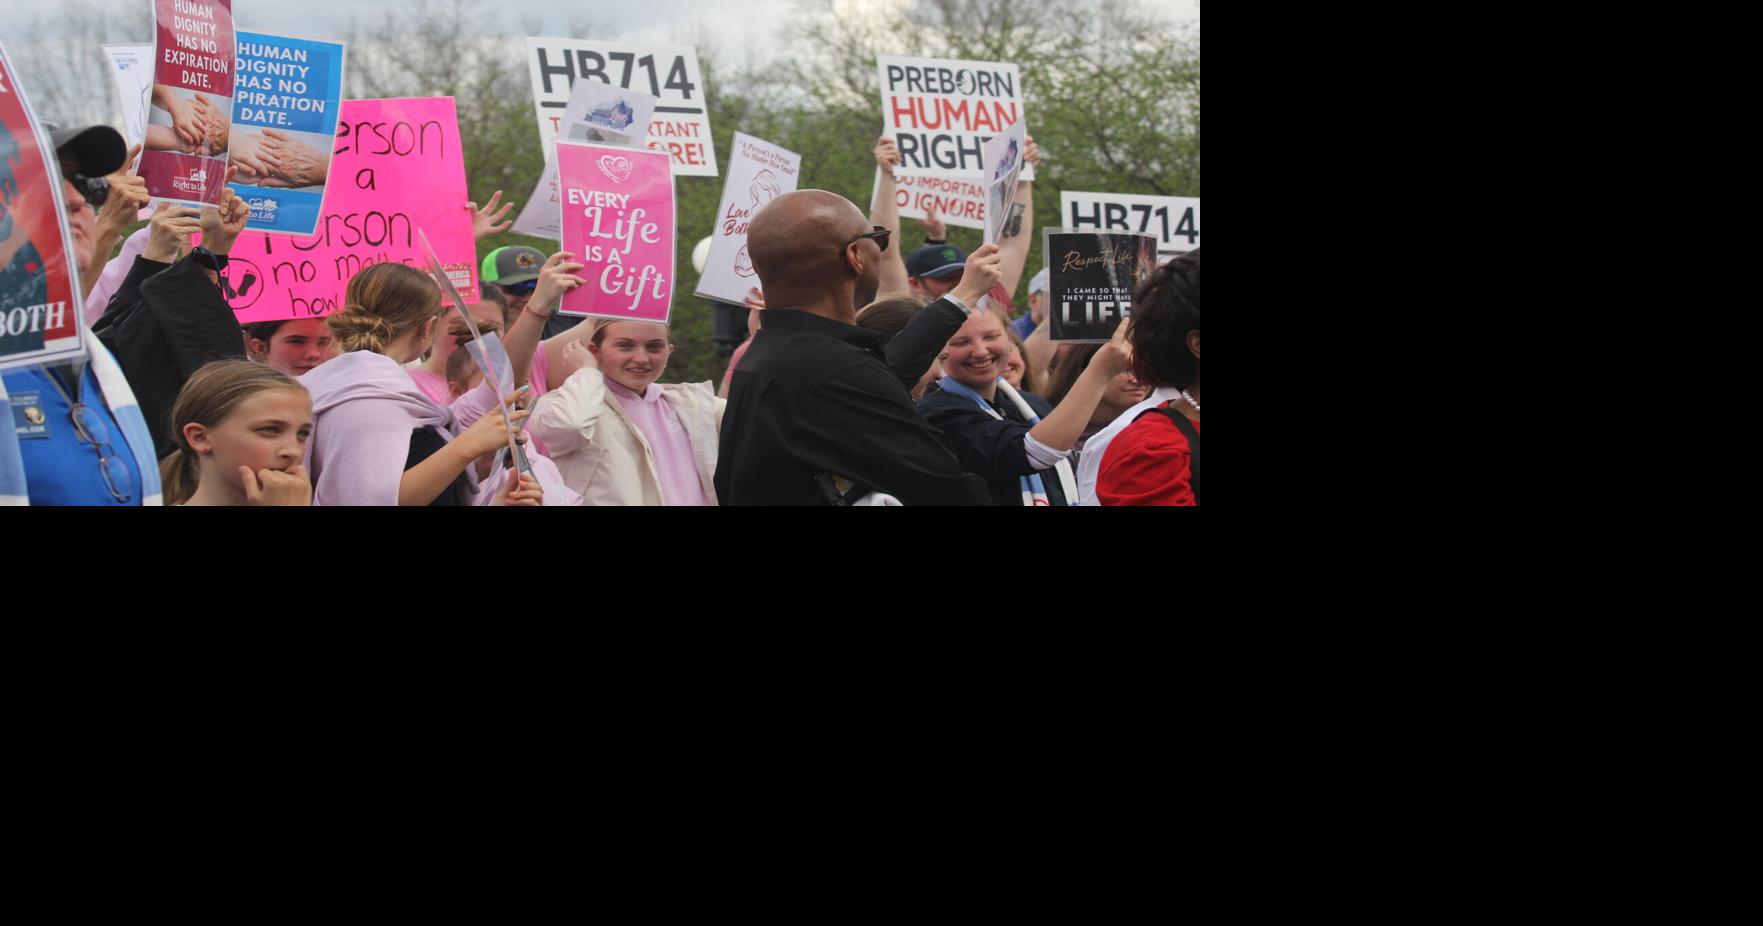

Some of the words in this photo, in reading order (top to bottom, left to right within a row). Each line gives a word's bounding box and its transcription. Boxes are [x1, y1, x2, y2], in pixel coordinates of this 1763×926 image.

[174, 0, 213, 19] HUMAN
[174, 16, 216, 37] DIGNITY
[176, 33, 198, 51] HAS
[201, 39, 217, 54] NO
[238, 42, 307, 63] HUMAN
[165, 48, 228, 75] EXPIRATION
[236, 58, 310, 79] DIGNITY
[182, 69, 211, 89] DATE.
[236, 74, 272, 90] HAS
[279, 79, 307, 95] NO
[537, 47, 695, 100] HB714
[887, 65, 1013, 98] PREBORN
[236, 90, 326, 113] PIRATION
[241, 107, 293, 126] DATE.
[891, 95, 1018, 132] HUMAN
[335, 120, 443, 159] rson
[896, 133, 1026, 171] RIGH
[355, 168, 375, 190] a
[917, 176, 985, 198] IMPORTAN
[568, 187, 631, 210] EVERY
[895, 189, 910, 208] O
[259, 210, 276, 220] Life
[726, 203, 751, 219] Love
[265, 210, 412, 255] rson
[584, 206, 661, 255] Life
[1071, 201, 1200, 245] HB714
[585, 245, 603, 263] IS
[607, 248, 622, 265] A
[1061, 249, 1113, 273] Respect
[1112, 244, 1133, 265] Life
[272, 260, 317, 285] no
[600, 264, 666, 311] Gift
[287, 288, 338, 317] how
[1062, 301, 1131, 325] LIFE
